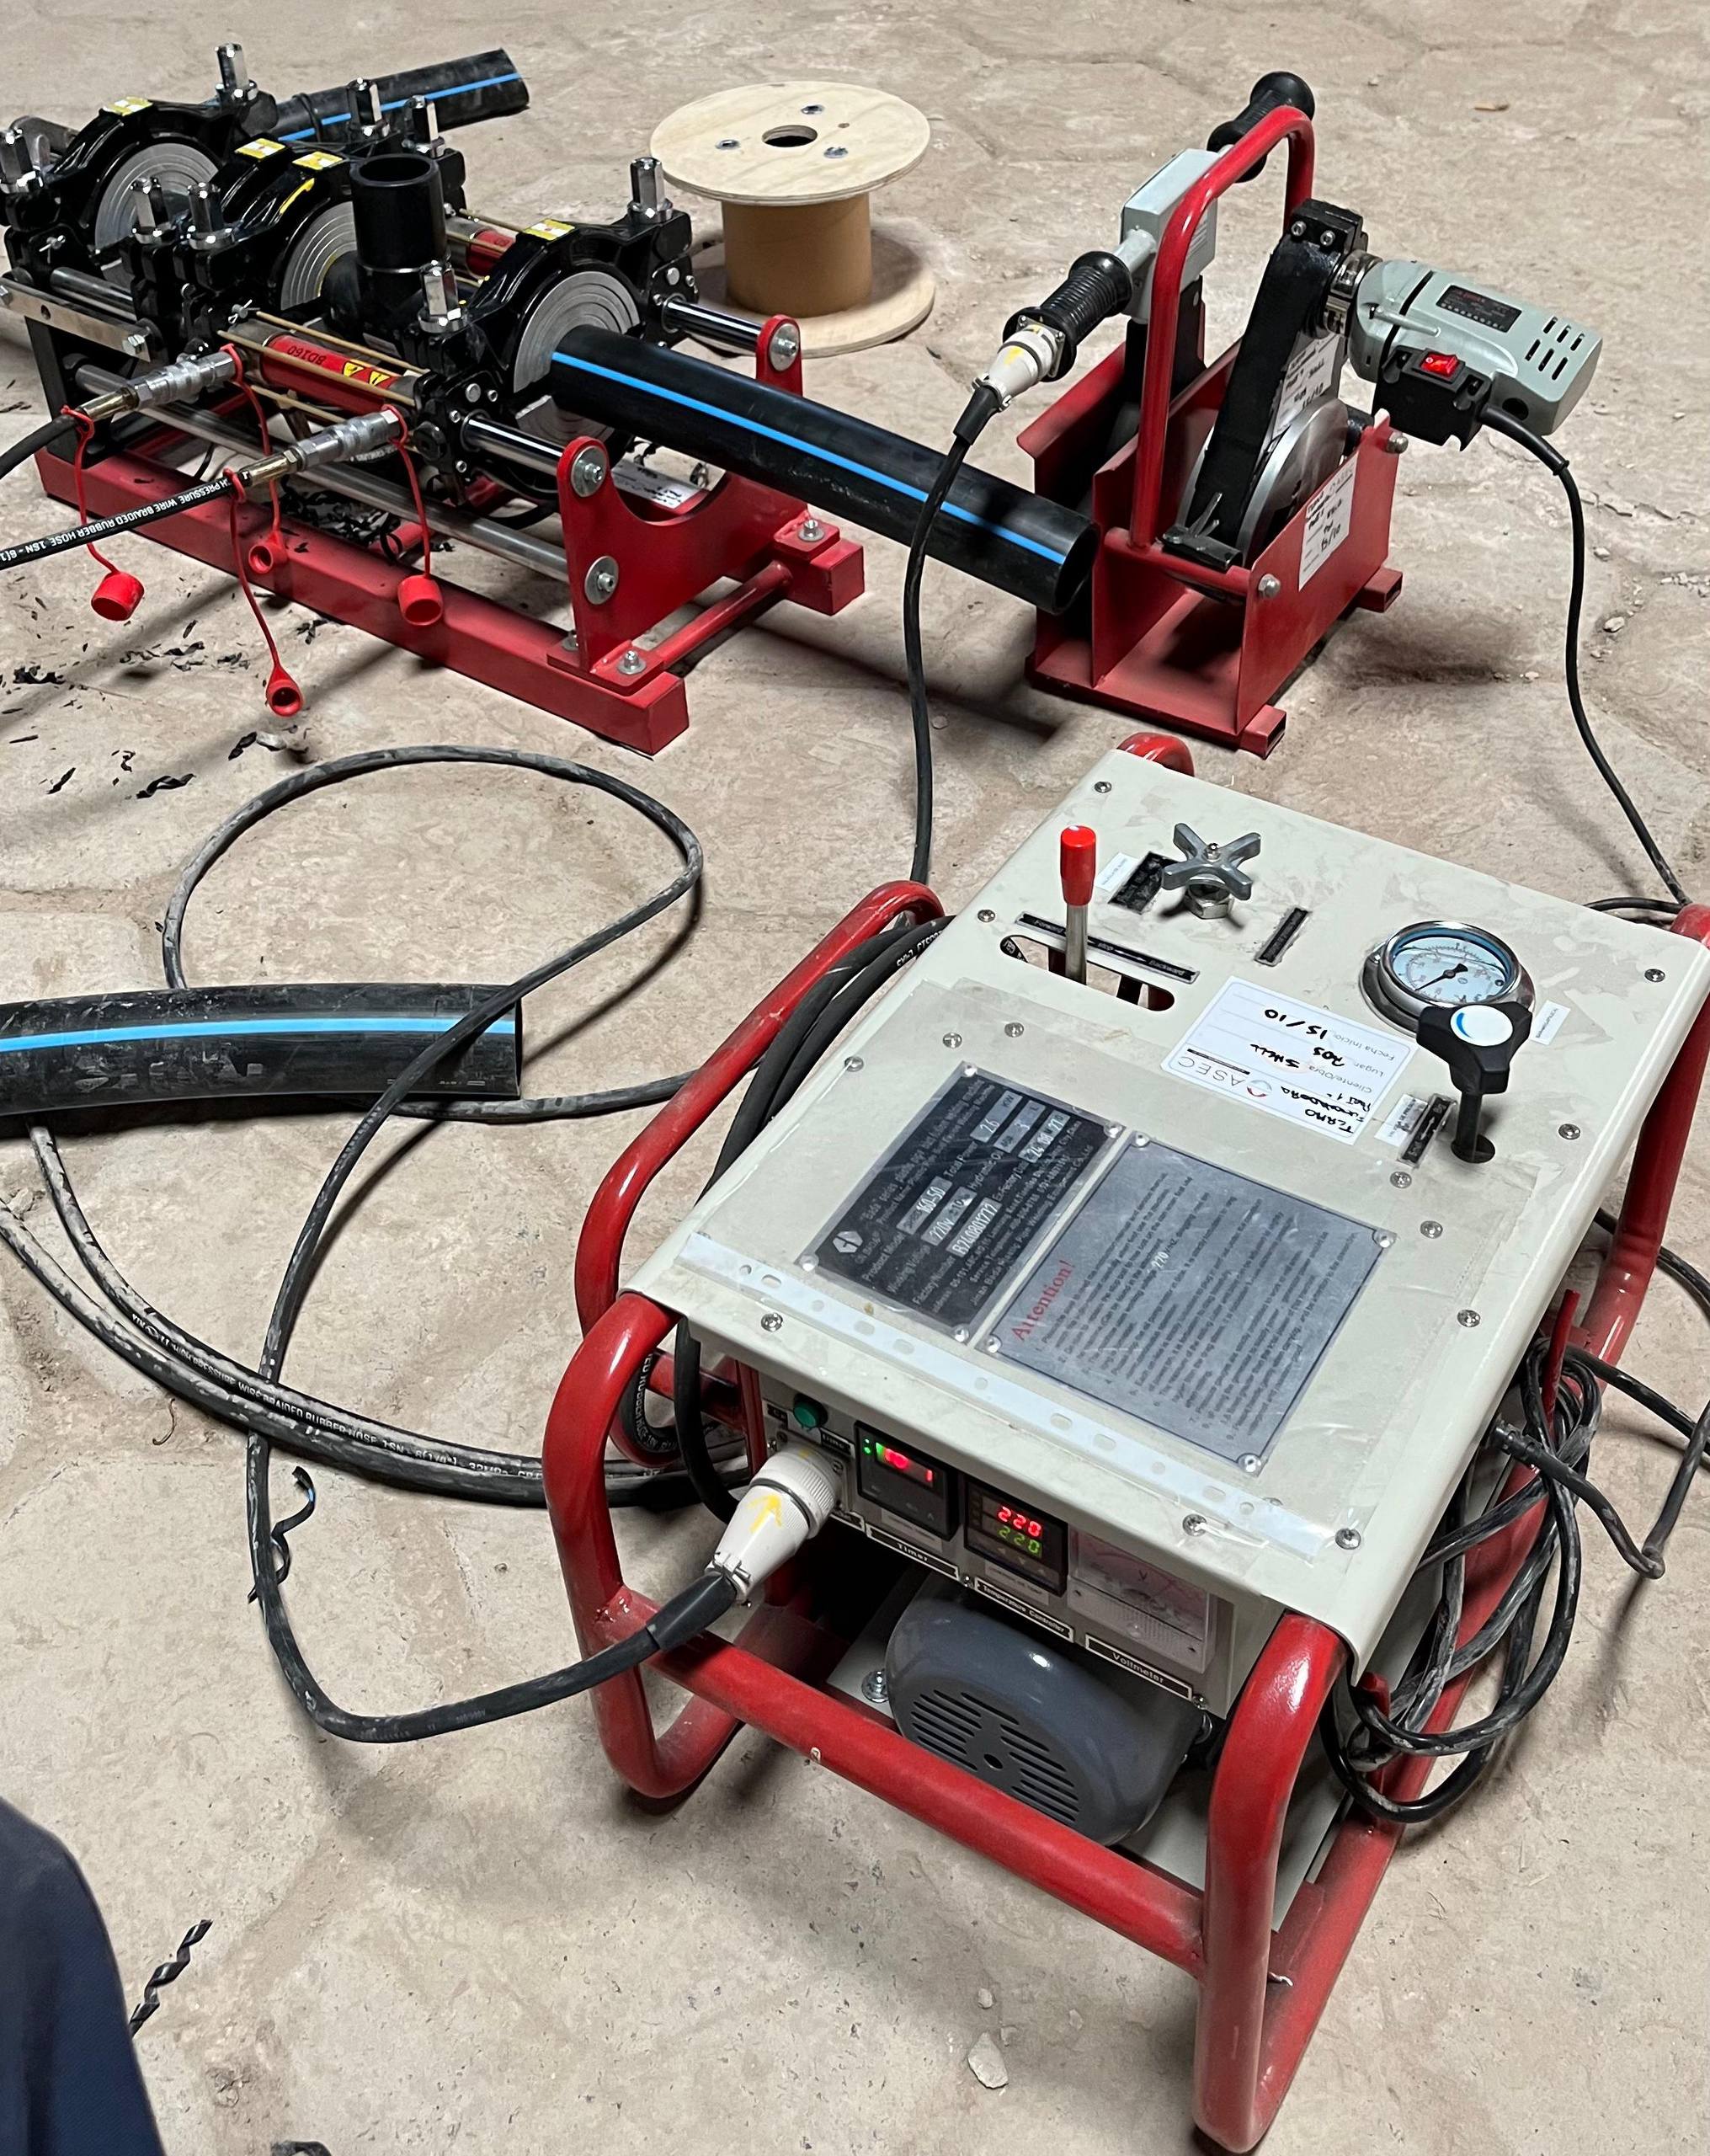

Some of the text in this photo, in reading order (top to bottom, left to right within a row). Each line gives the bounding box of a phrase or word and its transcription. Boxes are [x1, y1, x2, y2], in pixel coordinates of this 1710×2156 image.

[153, 499, 177, 512] WIRE
[180, 484, 221, 504] PRESSURE
[77, 518, 115, 537] RUBBER
[115, 506, 154, 526] BRAIDED
[49, 531, 77, 547] HOSE
[1175, 1054, 1245, 1088] ASEC
[1007, 1258, 1079, 1341] Attention!
[998, 1506, 1043, 1538] 220
[897, 1542, 928, 1561] Timer
[998, 1525, 1041, 1555] 220
[983, 1584, 1065, 1633] Temperature Controller
[1111, 1651, 1165, 1684] Voltmeter
